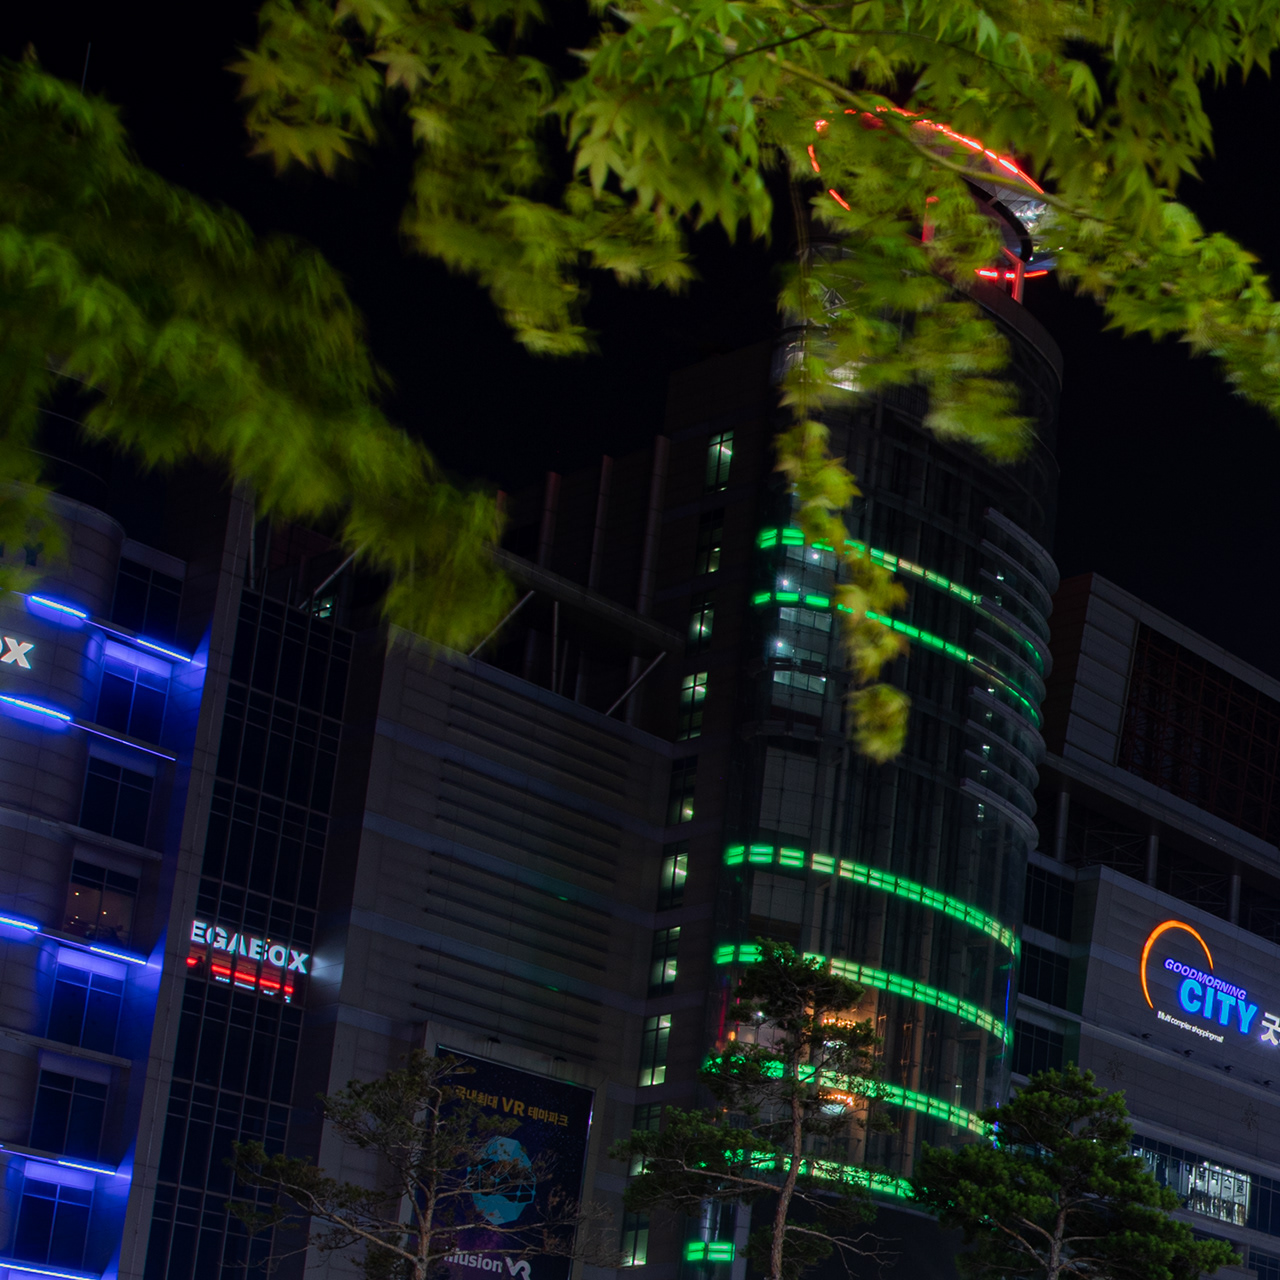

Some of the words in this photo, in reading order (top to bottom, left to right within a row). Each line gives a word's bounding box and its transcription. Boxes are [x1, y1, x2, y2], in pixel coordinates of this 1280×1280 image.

[0, 637, 35, 669] X
[1164, 958, 1247, 1001] GOODMORNING
[1179, 978, 1258, 1034] CITY
[455, 1085, 499, 1109] 국내최대
[502, 1097, 525, 1117] VR
[527, 1106, 568, 1127] 테마파크
